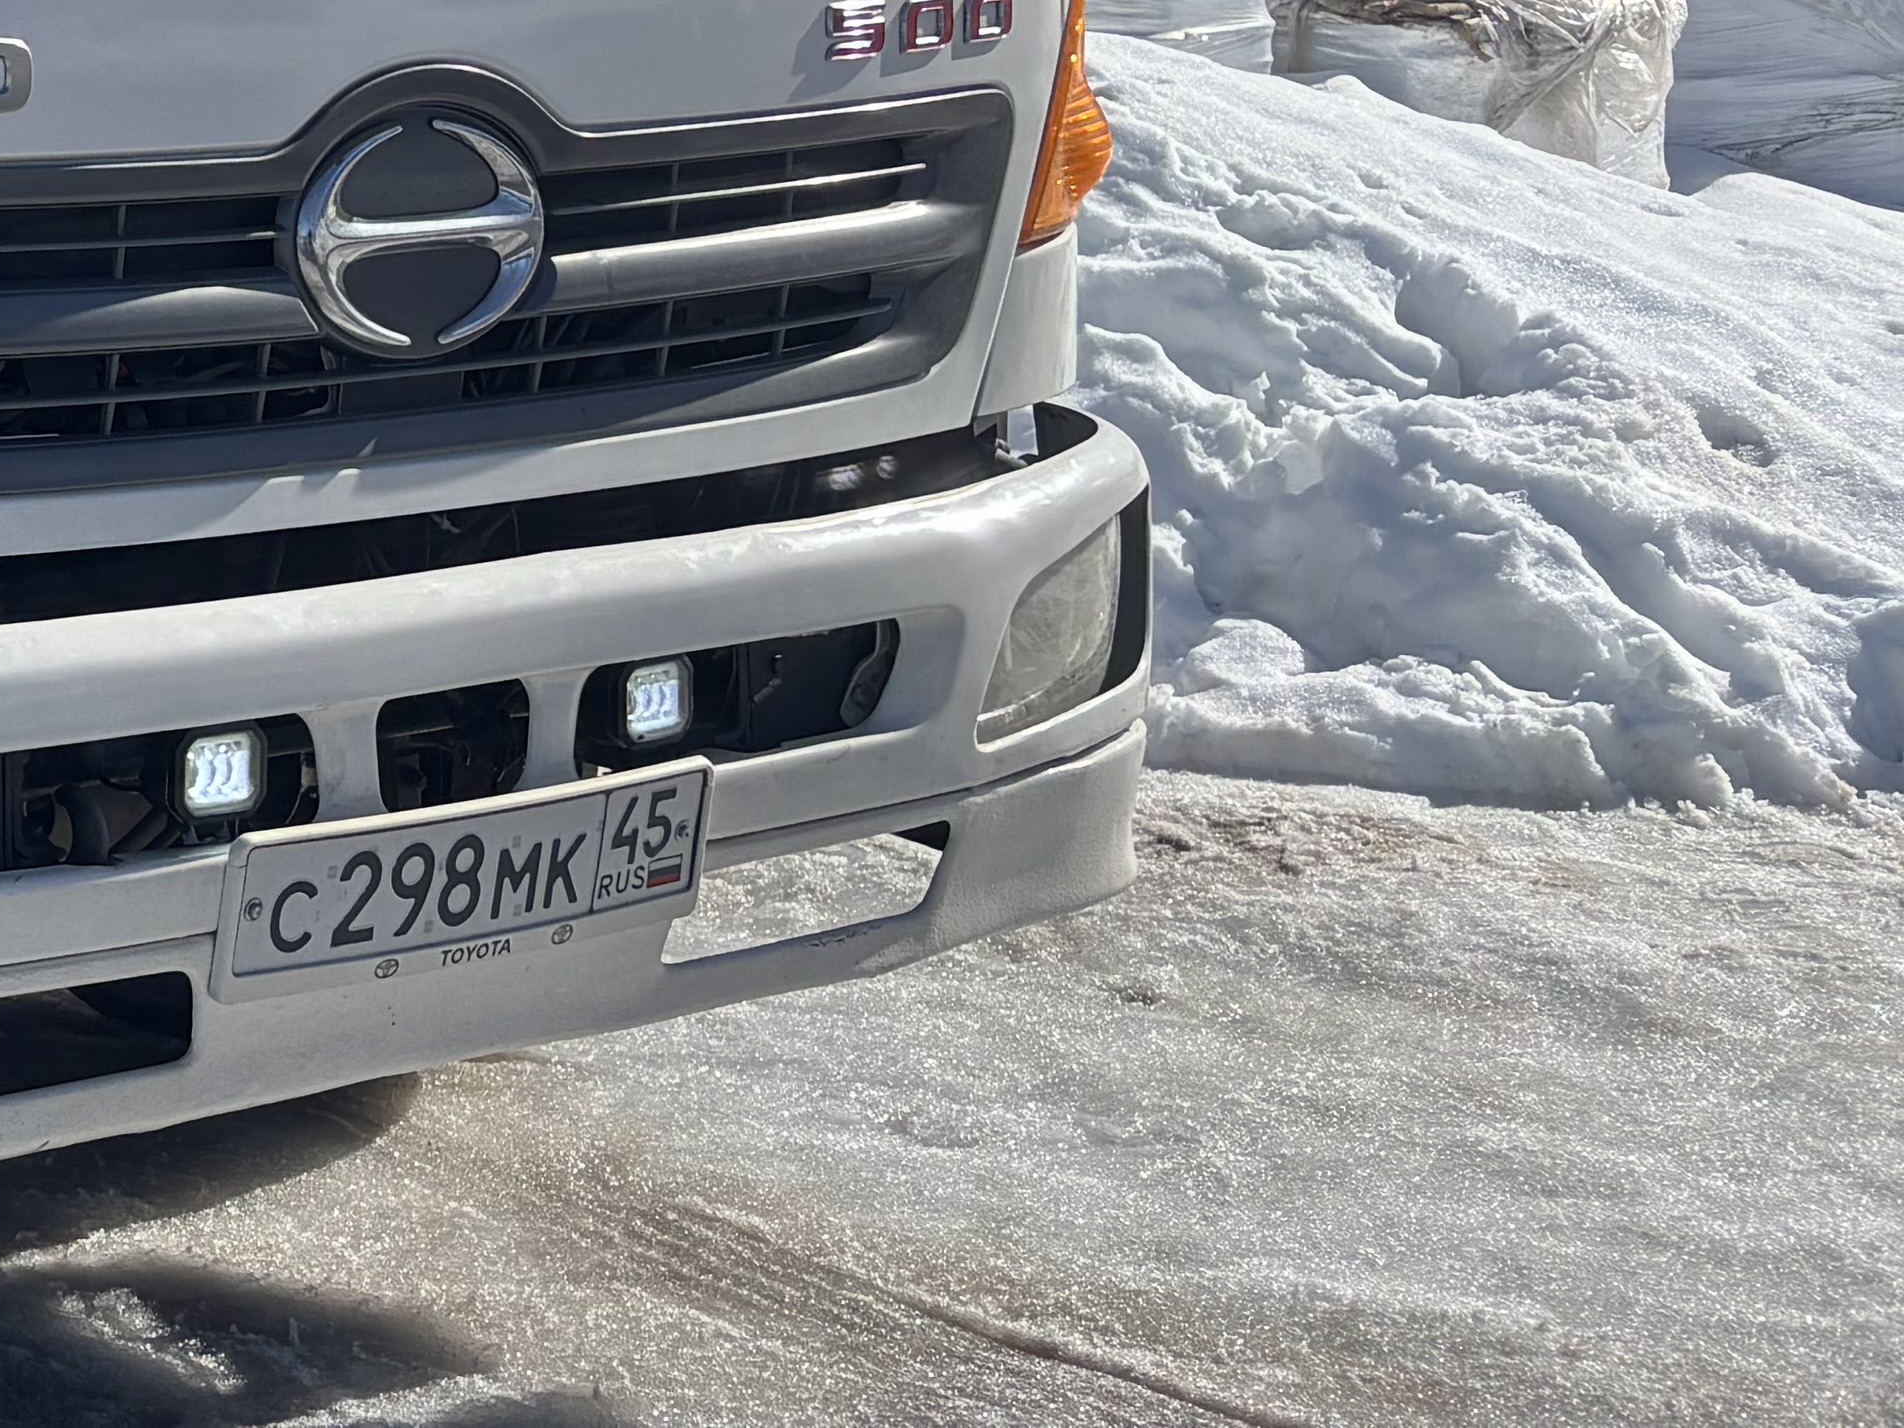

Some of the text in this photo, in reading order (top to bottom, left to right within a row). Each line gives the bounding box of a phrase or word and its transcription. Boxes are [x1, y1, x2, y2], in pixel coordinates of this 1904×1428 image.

[610, 786, 678, 865] 45
[596, 864, 646, 900] RUS
[440, 938, 513, 968] TOYOTA
